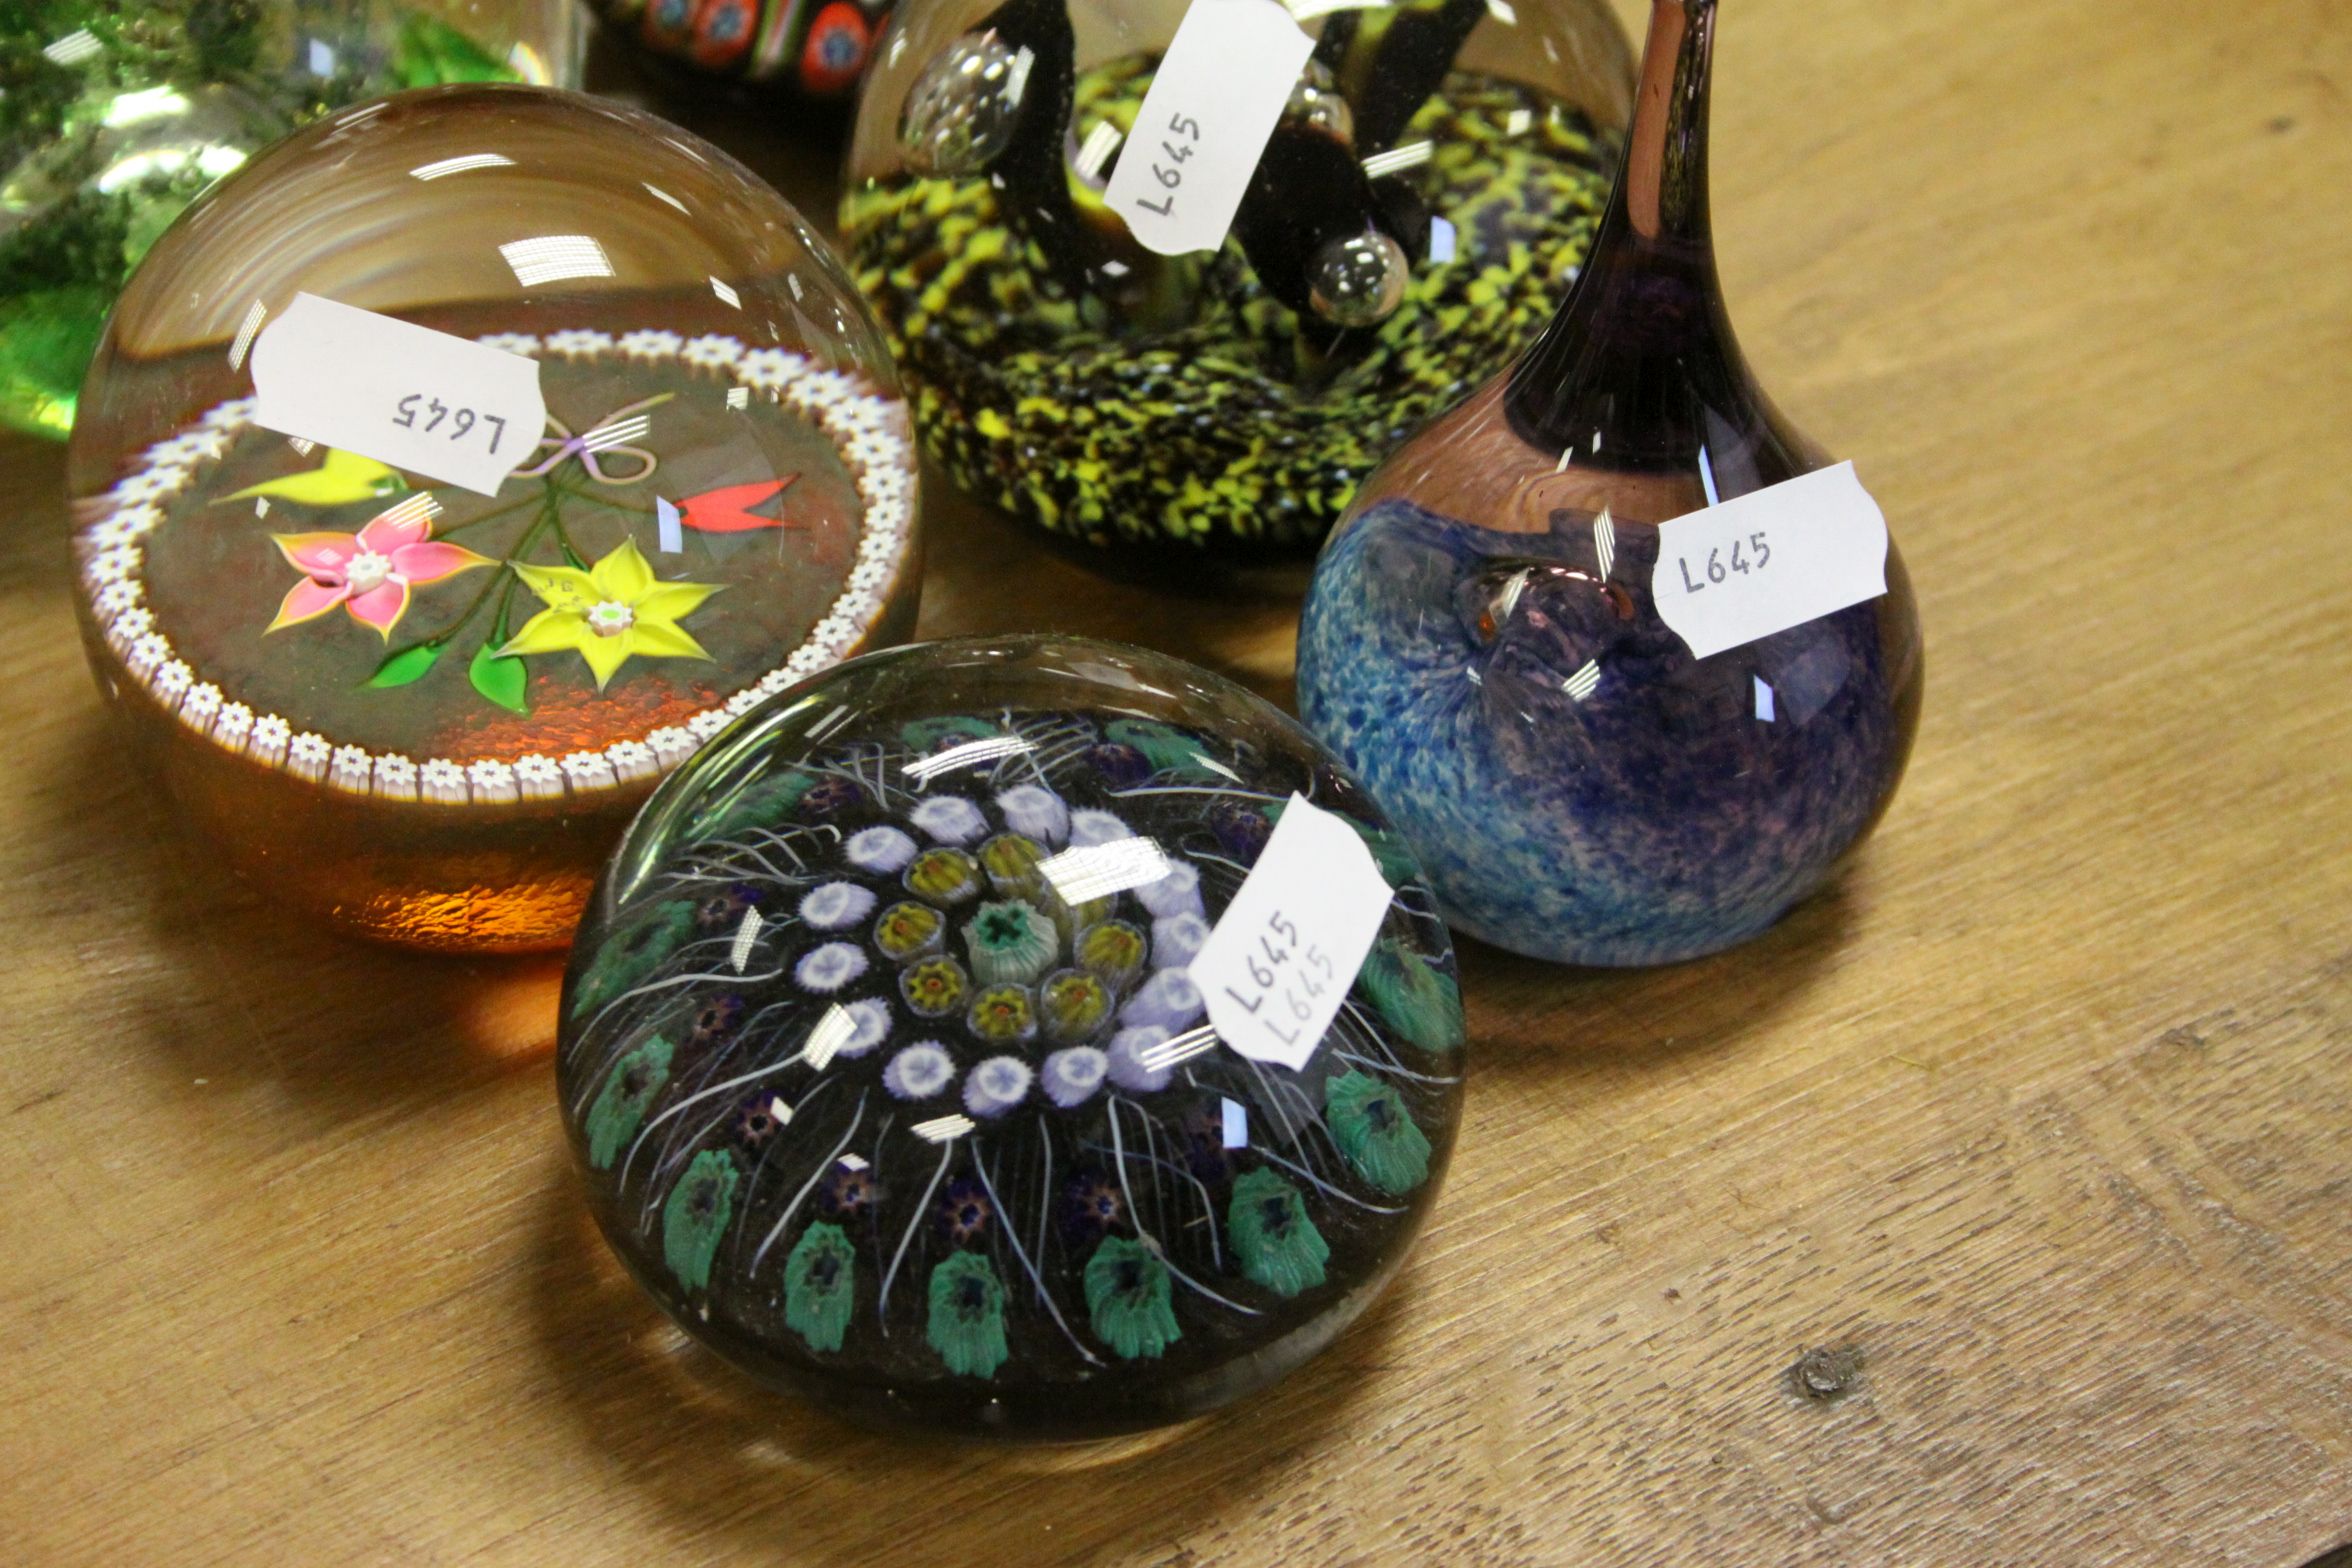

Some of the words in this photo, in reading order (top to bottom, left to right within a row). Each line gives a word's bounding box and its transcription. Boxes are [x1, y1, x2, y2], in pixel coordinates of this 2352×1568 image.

[1136, 113, 1200, 216] L645
[392, 394, 506, 454] L645
[1679, 532, 1771, 593] L645
[1226, 911, 1296, 1014] L645
[1264, 945, 1333, 1046] L645
